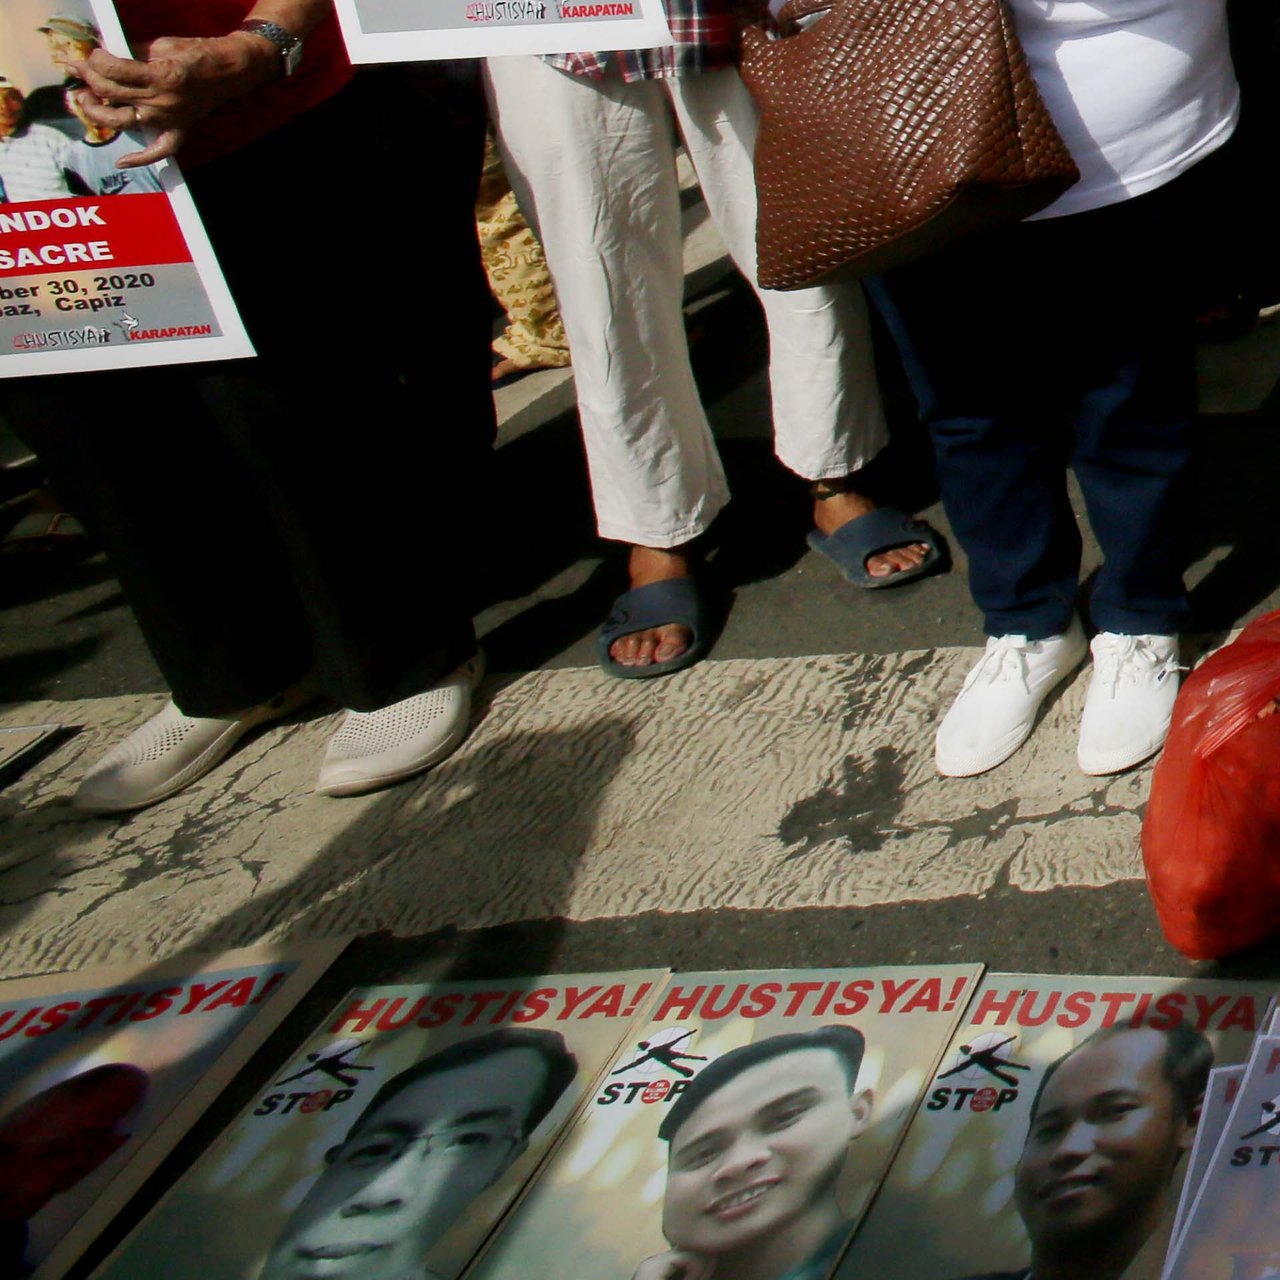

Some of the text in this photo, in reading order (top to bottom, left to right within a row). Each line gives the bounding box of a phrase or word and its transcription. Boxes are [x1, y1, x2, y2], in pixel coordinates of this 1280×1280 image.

[562, 3, 633, 18] KARAPATAN
[0, 206, 107, 233] NDOK
[47, 279, 88, 296] 30,
[94, 273, 155, 291] 2020
[55, 294, 126, 312] Capiz
[130, 325, 212, 341] KARAPATAN
[328, 982, 653, 1034] HUSTISYA!
[652, 977, 968, 1021] HUSTISYA!
